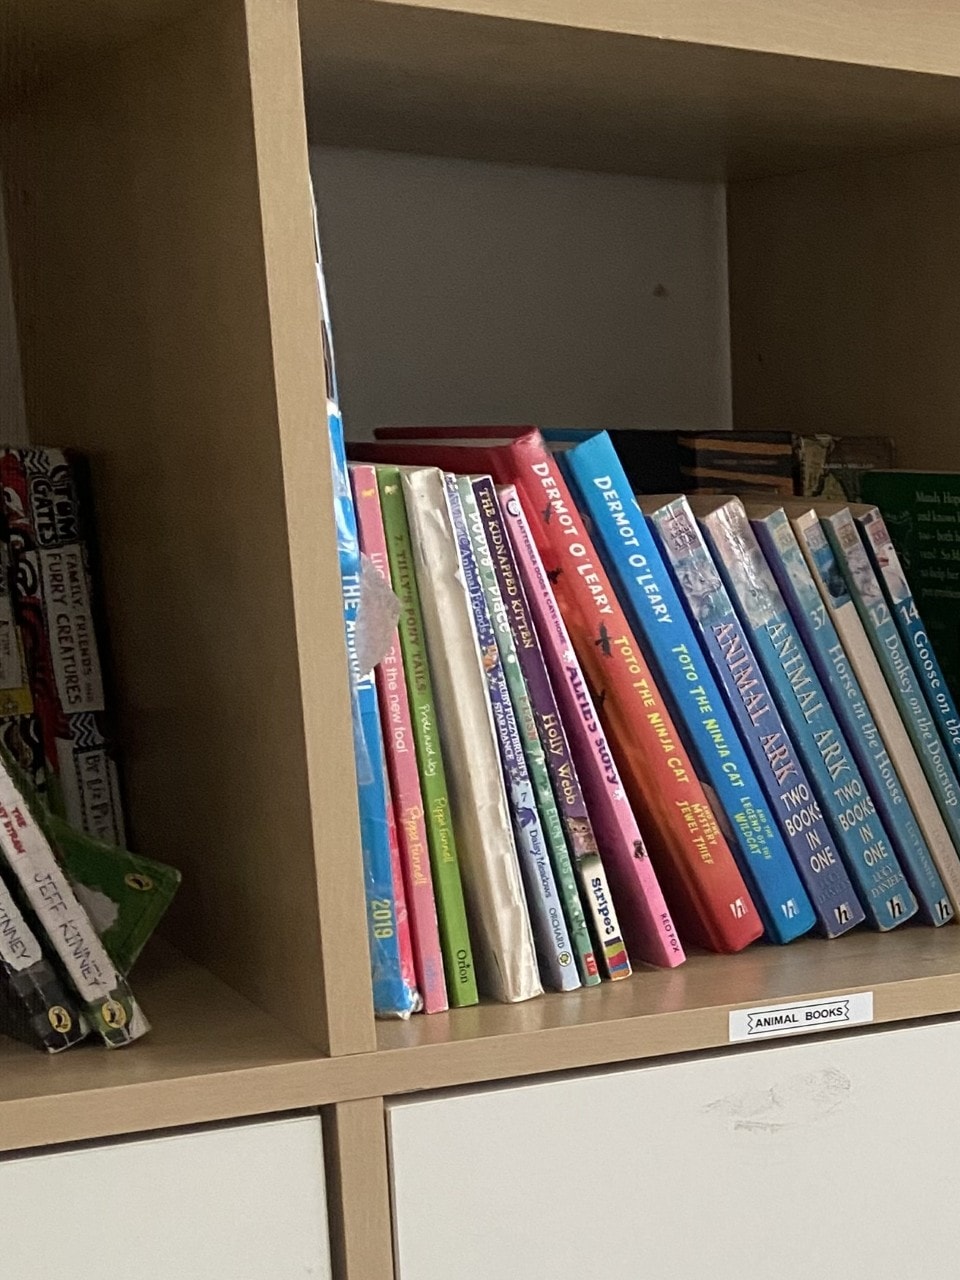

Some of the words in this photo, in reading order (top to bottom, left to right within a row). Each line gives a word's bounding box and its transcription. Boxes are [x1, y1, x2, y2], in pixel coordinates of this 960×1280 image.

[34, 477, 60, 546] GATES
[54, 482, 79, 541] TOM
[531, 461, 578, 538] DERMOT
[569, 542, 614, 617] O'LEARY
[592, 475, 640, 547] DERMOT
[627, 553, 673, 624] O'LEARY
[47, 551, 68, 607] FURRY
[479, 487, 496, 517] THE
[488, 520, 518, 596] KIDNAPPED
[511, 598, 535, 650] KITTEN
[517, 518, 538, 568] BATTERSEA
[534, 567, 547, 591] DOGS
[546, 600, 558, 622] CATS
[553, 620, 568, 645] HOME
[342, 571, 361, 610] THE
[459, 547, 476, 591] Animal
[469, 591, 488, 635] Friends
[404, 608, 420, 647] PONY
[809, 607, 827, 631] 37
[870, 603, 891, 629] 12
[900, 601, 921, 626] 14
[56, 612, 82, 706] CREATURES
[75, 614, 93, 675] FRIENDS
[384, 663, 398, 691] the
[914, 629, 941, 689] Goose
[936, 692, 951, 714] on
[388, 694, 403, 727] new
[494, 702, 507, 726] STAR
[498, 681, 512, 706] RUBY
[566, 664, 599, 734] ALFIE'S
[613, 635, 641, 675] TOTO
[632, 678, 656, 708] THE
[647, 711, 676, 754] NINJA
[666, 756, 690, 784] CAT
[712, 621, 771, 728] ANIMAL
[759, 731, 799, 787] ARK
[765, 622, 824, 725] ANIMAL
[812, 728, 851, 783] ARK
[671, 643, 699, 682] TOTO
[689, 685, 713, 714] THE
[702, 717, 732, 760] NINJA
[721, 761, 745, 789] CAT
[829, 642, 857, 699] Horse
[853, 701, 867, 720] in
[862, 722, 882, 749] the
[874, 748, 903, 805] House
[884, 633, 914, 694] Donkey
[909, 697, 923, 715] on
[917, 716, 933, 739] the
[927, 740, 959, 807] Doorstep
[393, 727, 409, 754] foal
[423, 734, 435, 757] and
[500, 726, 516, 762] DANCE
[504, 706, 531, 778] FUZZYBRUSH'S
[542, 712, 565, 758] Holly
[557, 761, 577, 807] Webb
[424, 756, 438, 779] Joy
[433, 797, 448, 829] Pippa
[780, 783, 810, 812] TWO
[834, 778, 862, 808] TWO
[405, 805, 425, 841] Pippa
[676, 800, 699, 834] JEWEL
[693, 835, 714, 866] THIEF
[691, 803, 718, 846] MYSTERY
[733, 812, 763, 857] WILDCAT
[740, 795, 764, 833] LEGEND
[784, 801, 823, 838] BOOKS
[838, 796, 877, 833] BOOKS
[439, 828, 455, 864] Funnell
[530, 829, 543, 856] Daisy
[804, 830, 823, 852] IN
[859, 827, 874, 848] IN
[863, 842, 888, 868] ONE
[411, 841, 428, 885] Funnell
[536, 857, 554, 899] Meadows
[810, 846, 836, 874] ONE
[371, 899, 394, 939] 2019
[591, 876, 617, 935] Stripes
[34, 872, 68, 912] JEFF
[59, 918, 107, 988] KINNEY
[549, 907, 567, 950] ORCHARD
[658, 910, 673, 932] RED
[667, 934, 682, 955] FOX
[457, 947, 476, 984] Orion
[755, 1013, 800, 1029] ANIMAL
[804, 1006, 845, 1022] BOOKS
